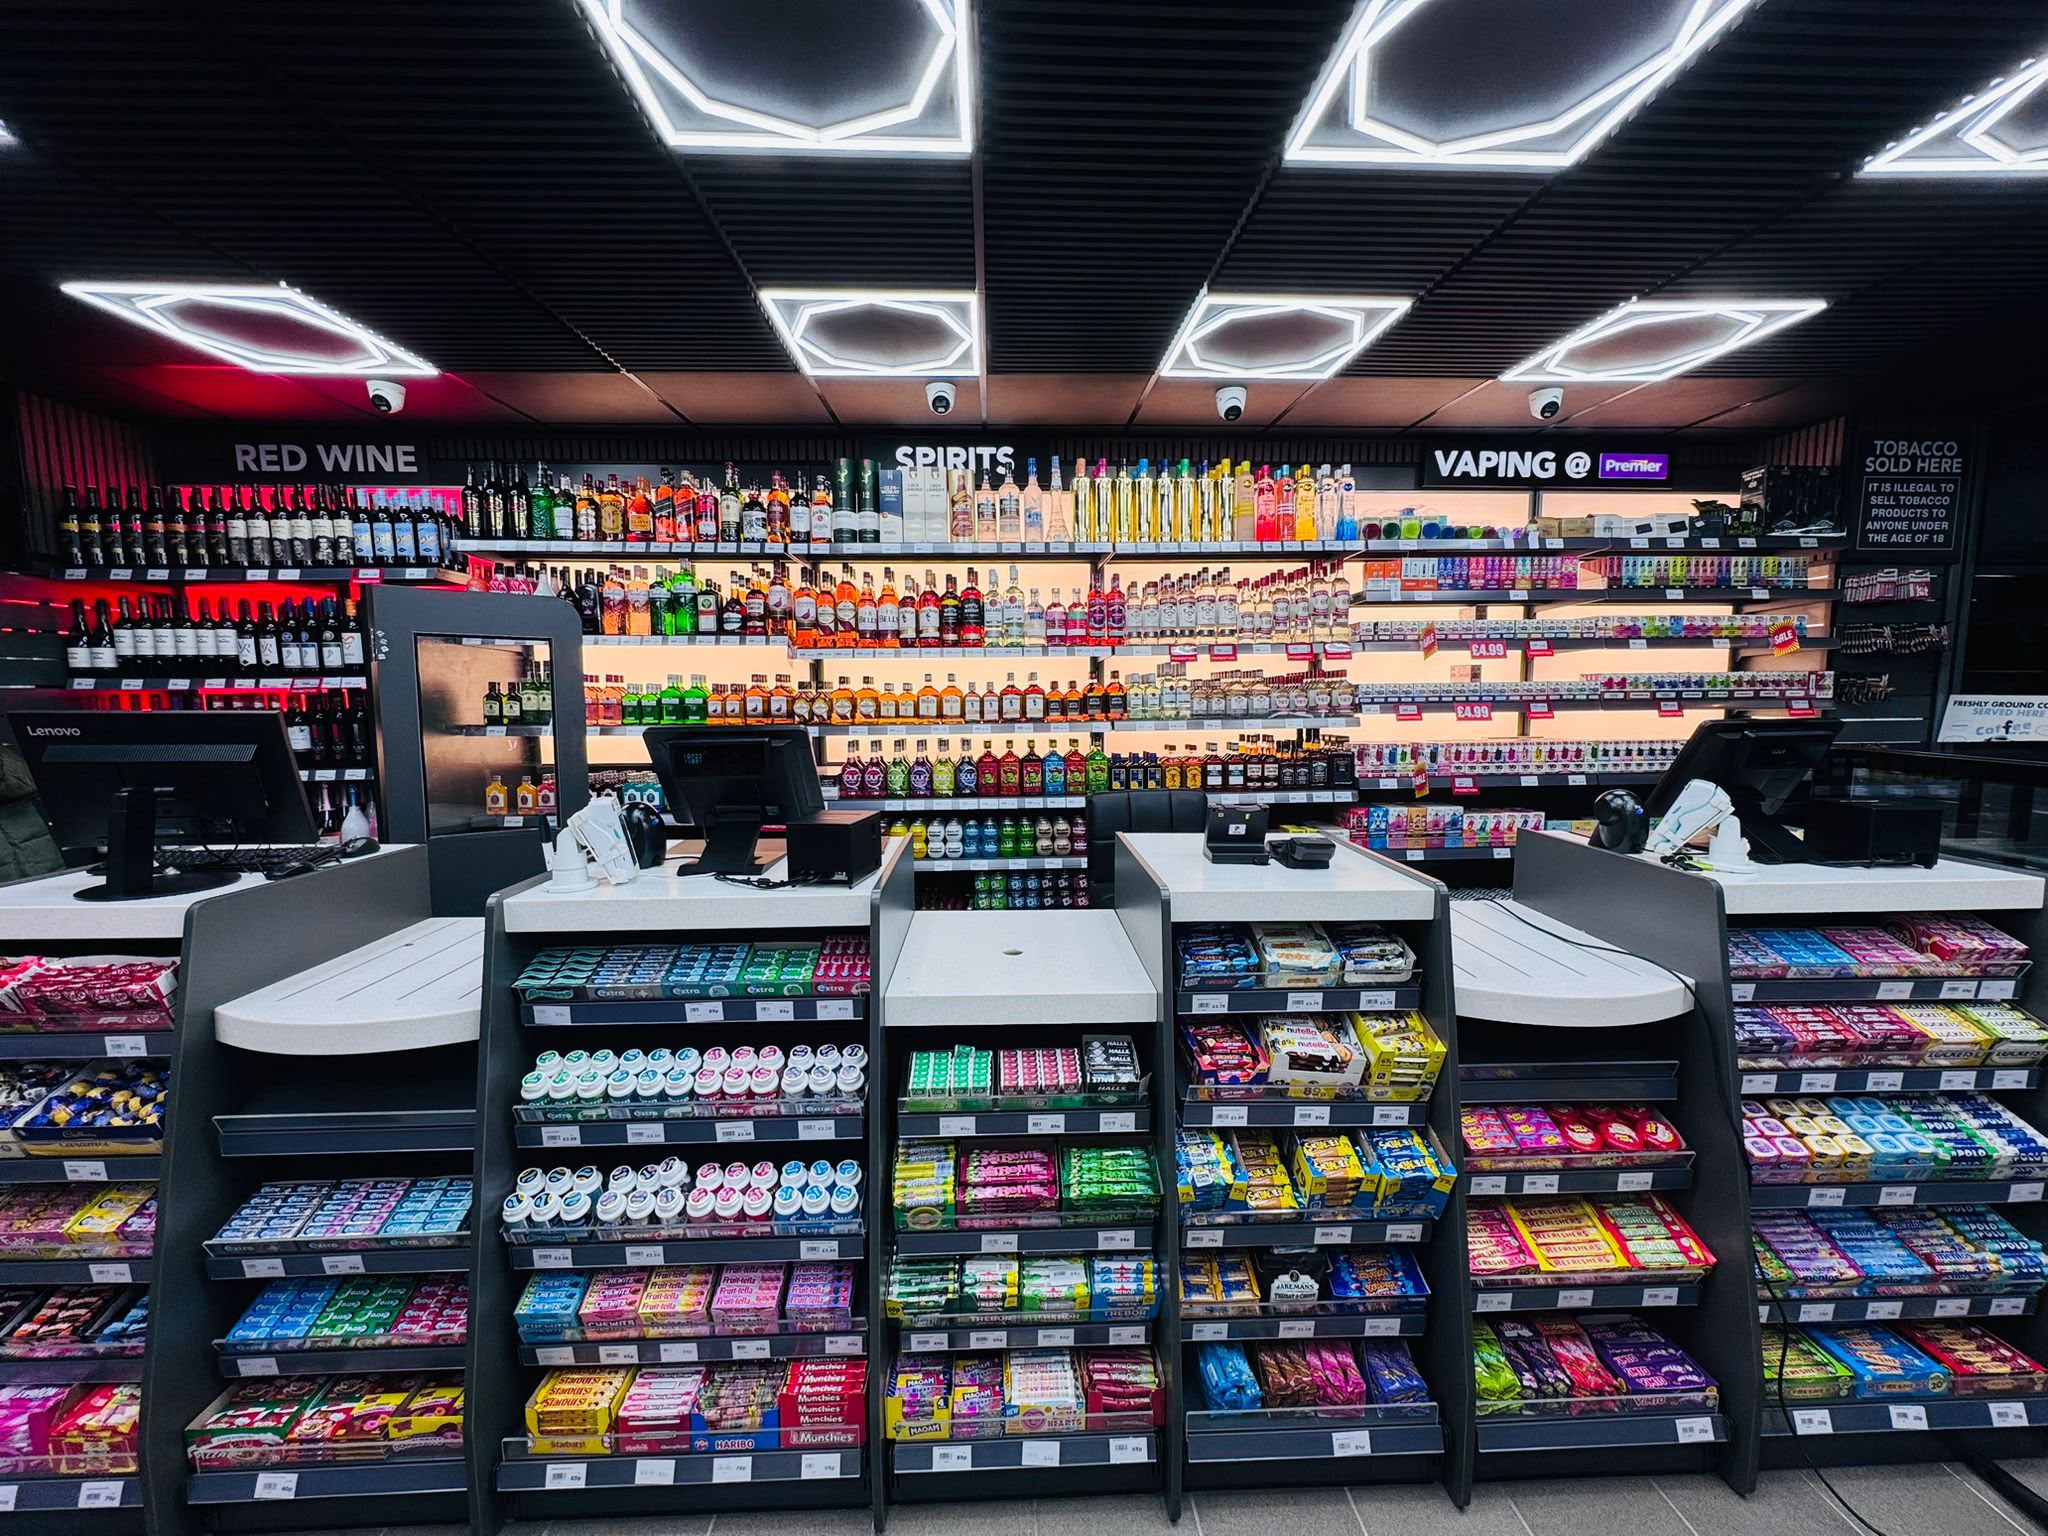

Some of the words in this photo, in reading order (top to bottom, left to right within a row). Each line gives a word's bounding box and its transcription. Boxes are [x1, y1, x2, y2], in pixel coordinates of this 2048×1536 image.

[1874, 441, 1958, 456] TOBACCO
[235, 445, 308, 472] RED
[317, 445, 418, 472] WINE
[895, 446, 1015, 473] SPIRITS
[1435, 450, 1556, 478] VAPING
[1565, 452, 1591, 479] @
[1606, 459, 1662, 472] Premier
[1865, 458, 1912, 472] SOLD
[1916, 458, 1962, 472] HERE
[1869, 484, 1878, 492] IT
[1881, 484, 1891, 492] IS
[1894, 484, 1937, 492] ILLEGAL
[1940, 484, 1954, 492] TO
[1870, 496, 1895, 504] SELL
[1899, 496, 1950, 504] TOBACCO
[1872, 509, 1928, 517] PRODUCTS
[1932, 509, 1946, 517] TO
[1866, 522, 1909, 530] ANYONE
[1912, 522, 1948, 530] UNDER
[1868, 534, 1888, 542] THE
[1890, 534, 1912, 542] AGE
[1915, 534, 1929, 542] OF
[1774, 629, 1793, 644] SALE
[1472, 644, 1504, 656] £4.99
[1457, 706, 1489, 718] £4.99
[27, 726, 80, 735] Lenovo
[1287, 1027, 1317, 1036] nutella
[1304, 1088, 1326, 1096] 89p
[1529, 1218, 1581, 1226] REFRESHERS
[1535, 1231, 1588, 1239] REFRESHERS
[1545, 1244, 1601, 1253] REFRESHERS
[2000, 1241, 2028, 1249] POLO
[1554, 1257, 1610, 1266] REFRESHERS
[600, 1288, 630, 1296] CHEWITS
[645, 1292, 679, 1300] Fruit-tella
[642, 1302, 676, 1310] Fruit-tella
[588, 1319, 635, 1327] CHEWITS
[907, 1378, 935, 1386] MAOAM
[802, 1385, 844, 1393] Munchies
[798, 1394, 840, 1402] Munchies
[964, 1390, 991, 1399] MAOAM
[543, 1399, 587, 1407] Starburst
[799, 1405, 840, 1413] Munchies
[1006, 1407, 1018, 1415] NEW
[910, 1424, 940, 1435] MAOAM
[801, 1433, 853, 1442] Munchies
[716, 1439, 754, 1449] HARIBO
